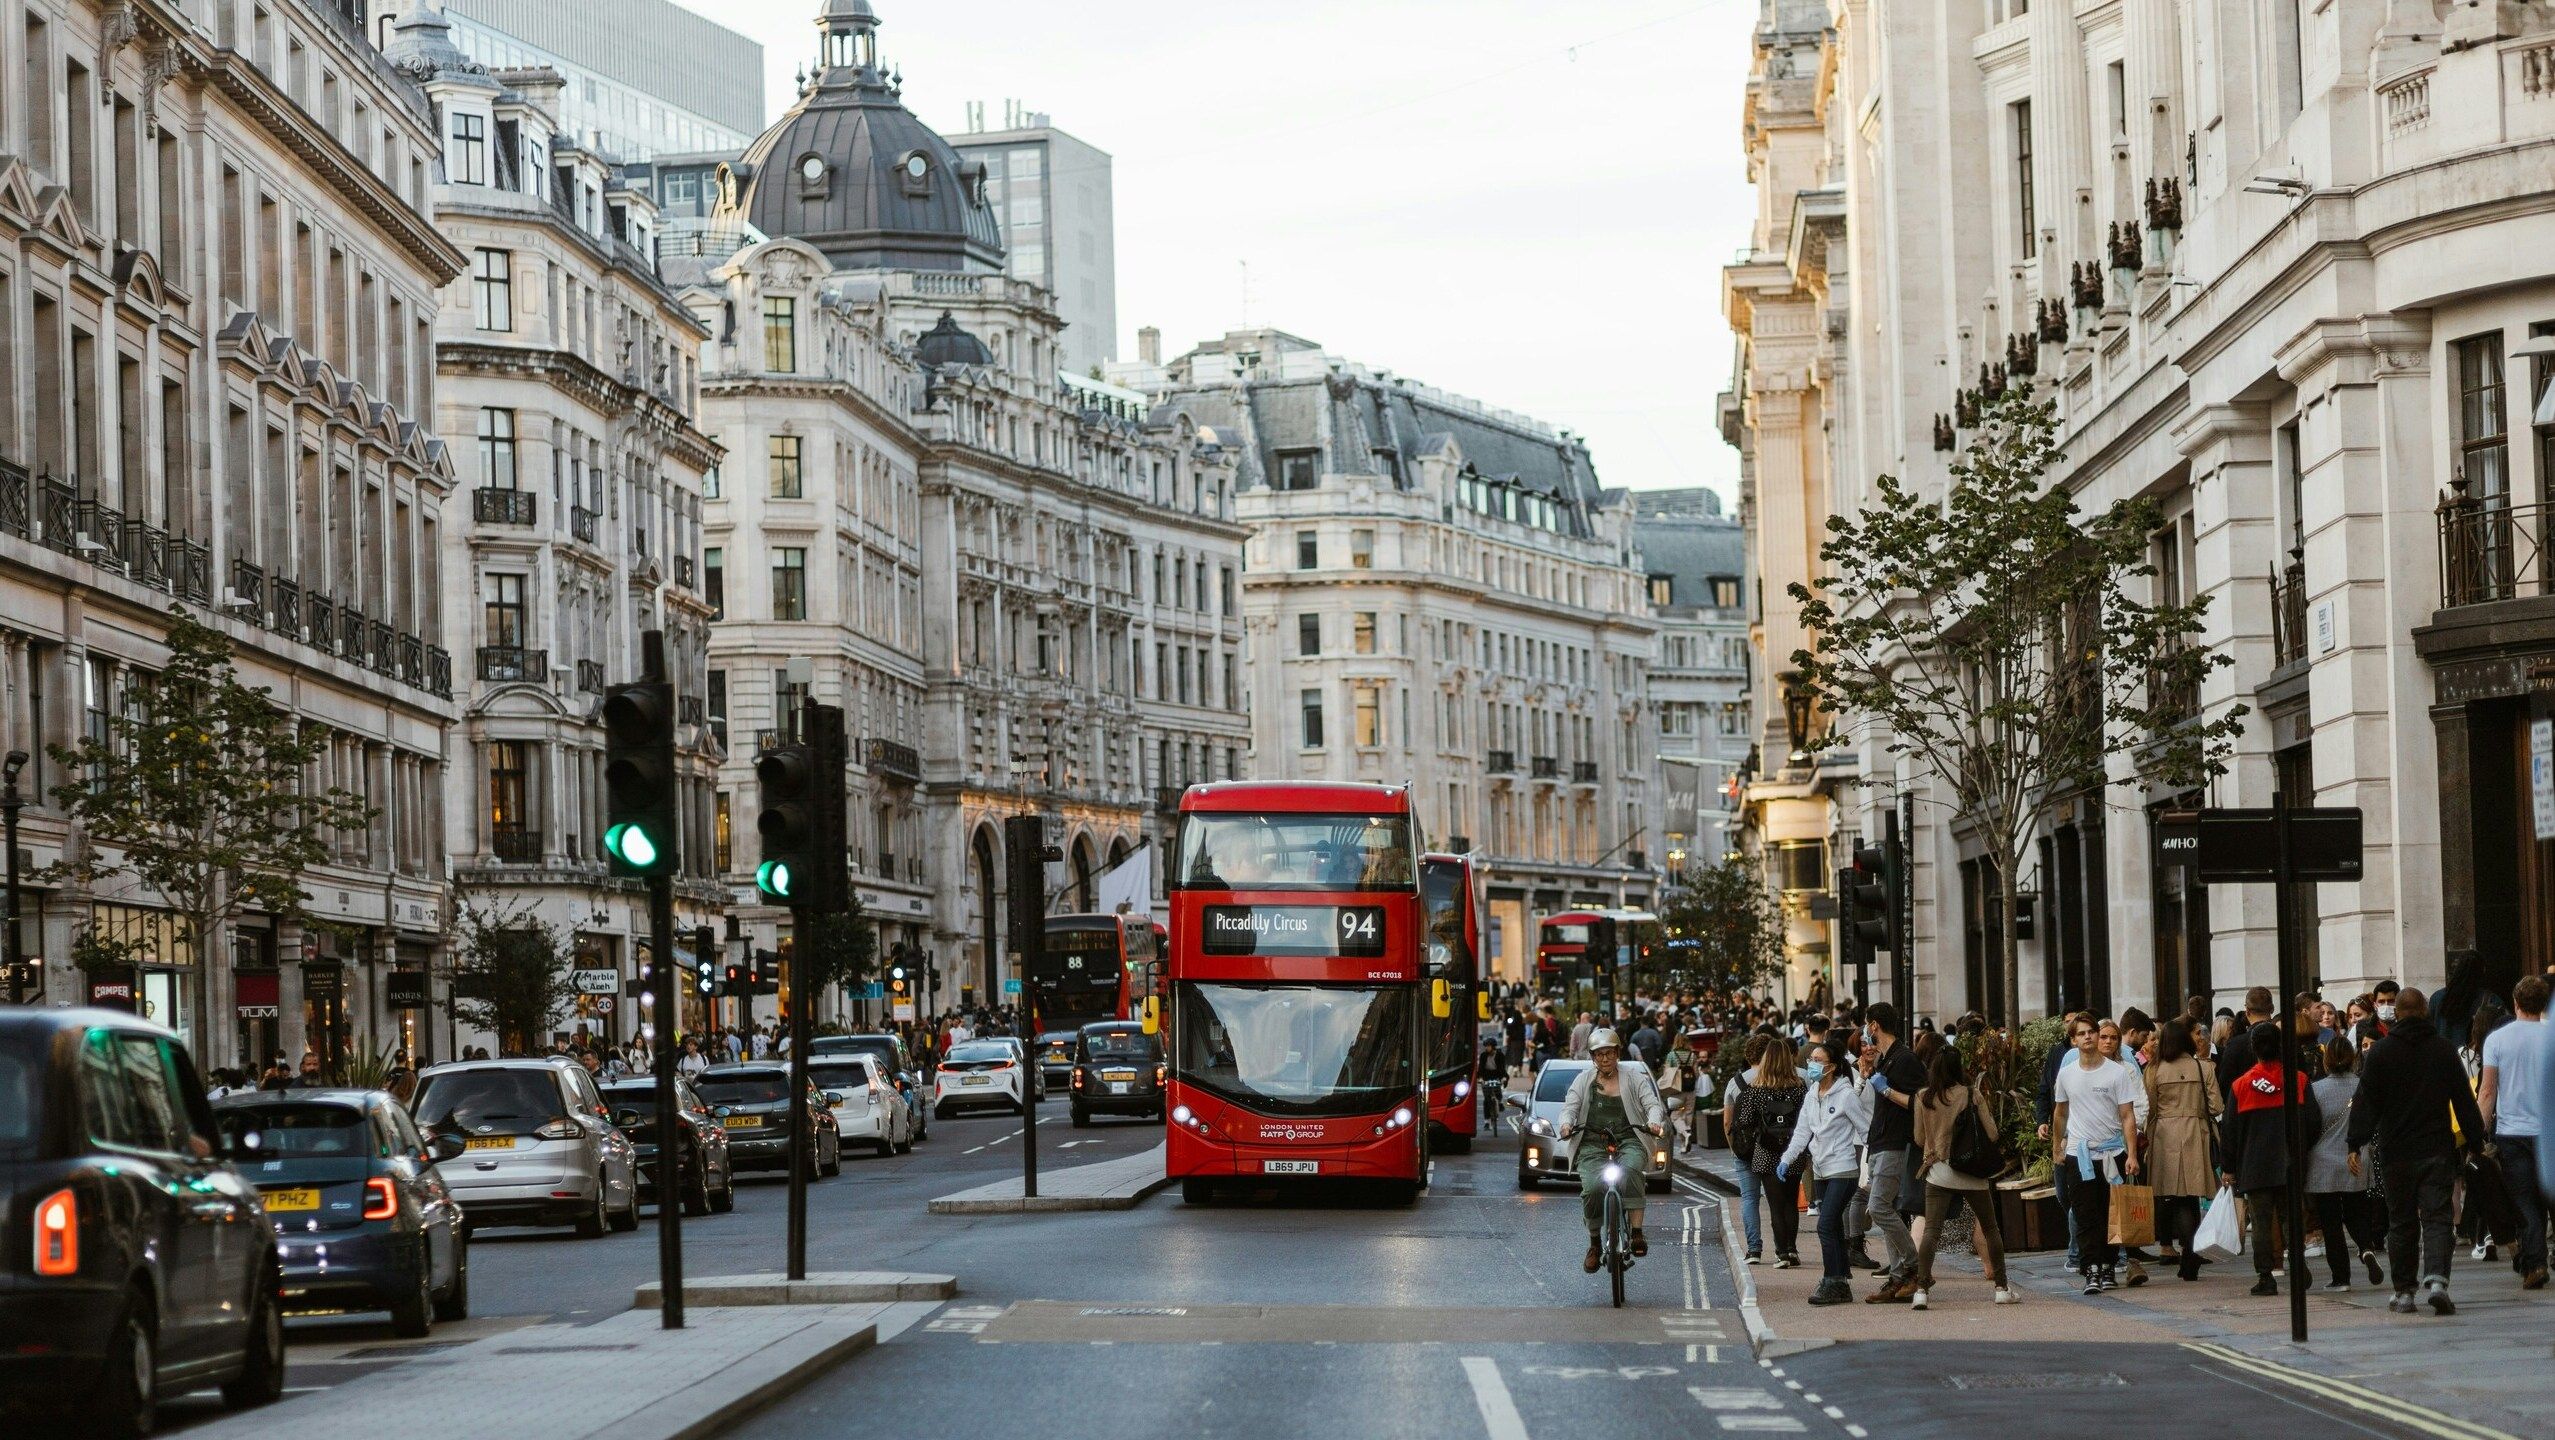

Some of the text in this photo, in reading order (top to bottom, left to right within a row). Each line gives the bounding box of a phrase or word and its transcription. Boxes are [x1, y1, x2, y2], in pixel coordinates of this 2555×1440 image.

[1216, 912, 1308, 935] Piccadilly Circus
[1341, 912, 1376, 939] 94
[1068, 956, 1082, 969] 88
[584, 972, 614, 981] Marble
[1368, 971, 1402, 979] BCE 47018
[94, 985, 129, 998] CAMPER
[238, 1005, 278, 1018] TUMI
[599, 1001, 612, 1009] 20
[1268, 1162, 1315, 1172] LB69 JPU
[278, 1192, 308, 1207] PHZ
